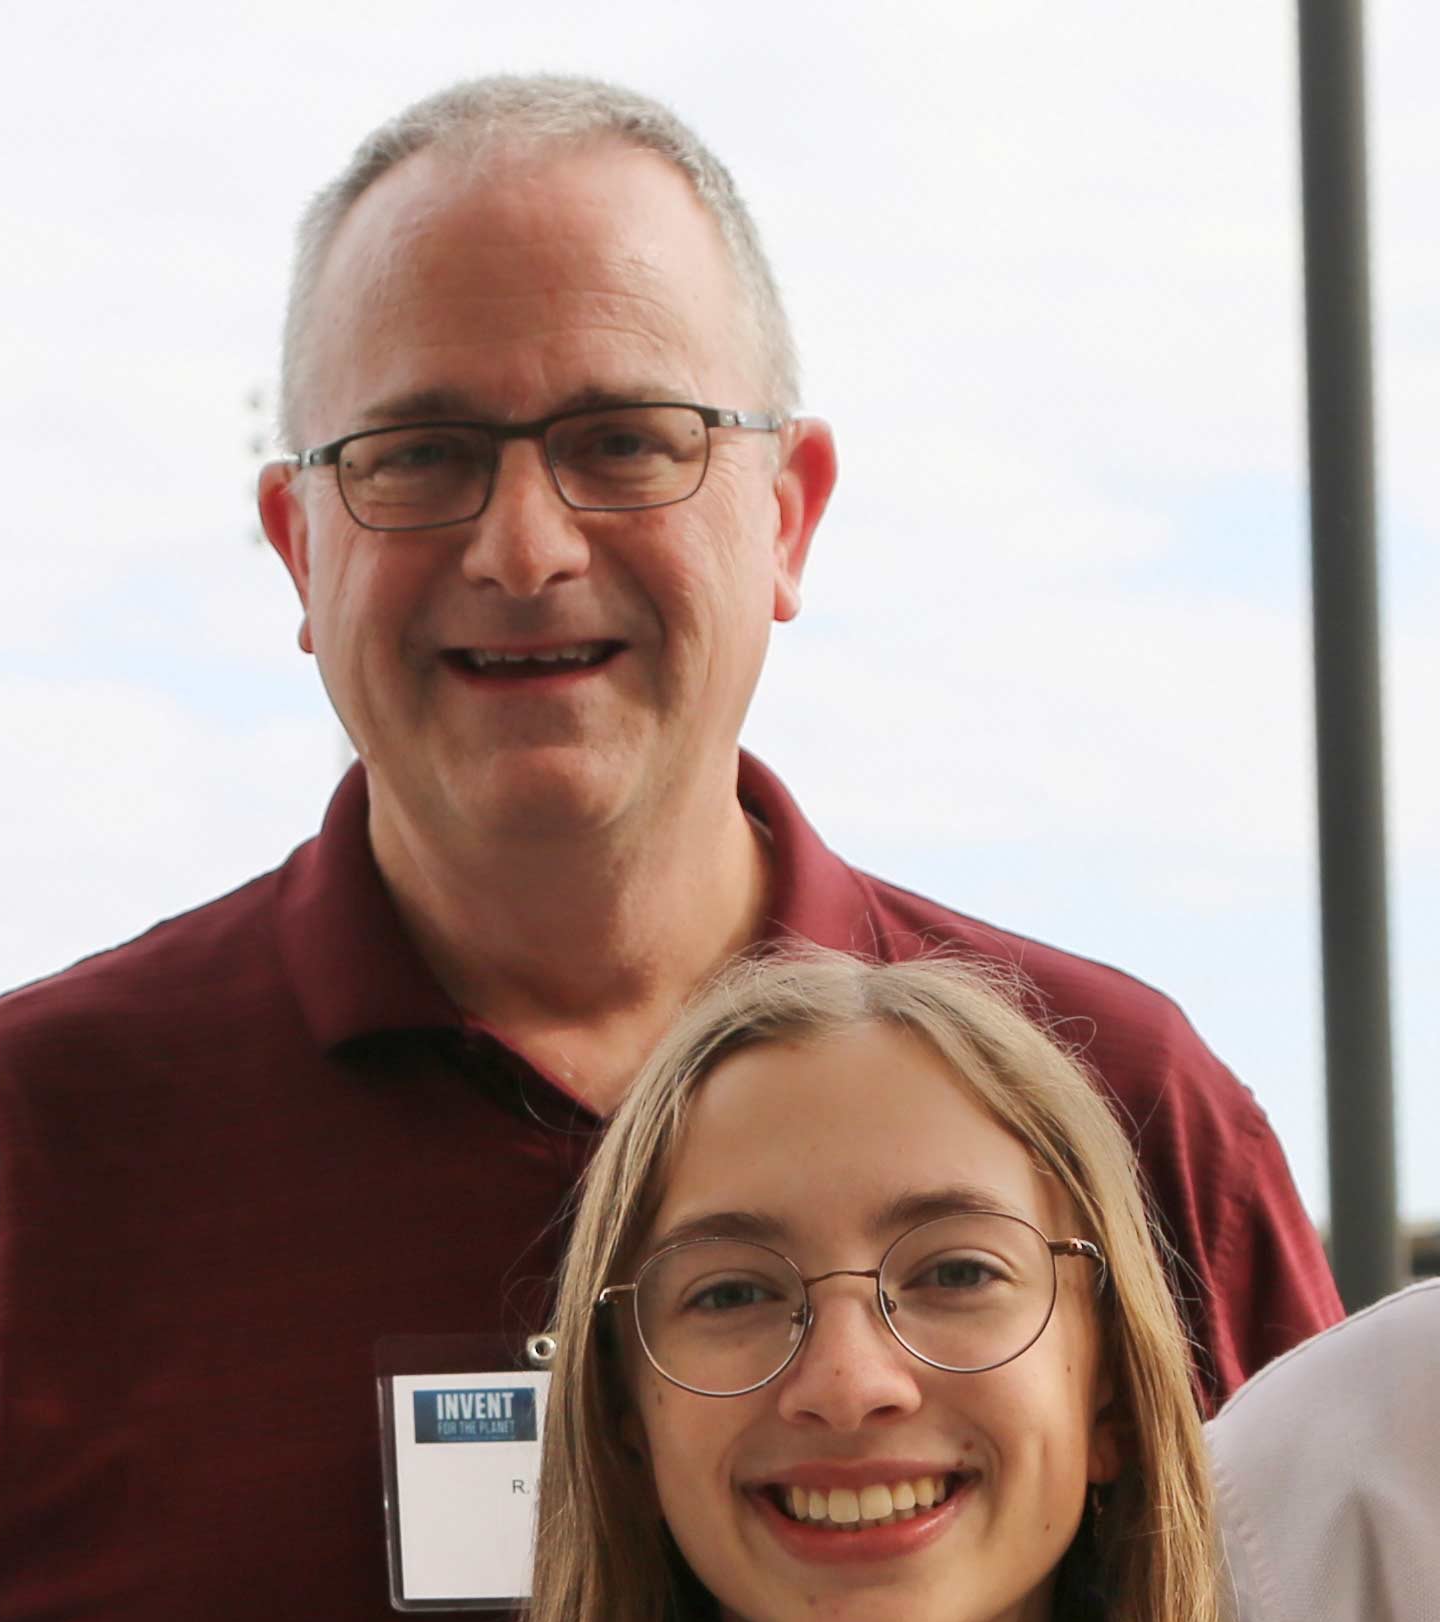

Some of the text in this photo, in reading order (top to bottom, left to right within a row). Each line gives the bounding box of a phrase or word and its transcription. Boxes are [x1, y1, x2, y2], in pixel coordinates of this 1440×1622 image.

[437, 1391, 514, 1420] INVENT
[438, 1420, 515, 1435] FOR THE PLANET
[512, 1479, 530, 1494] R.
